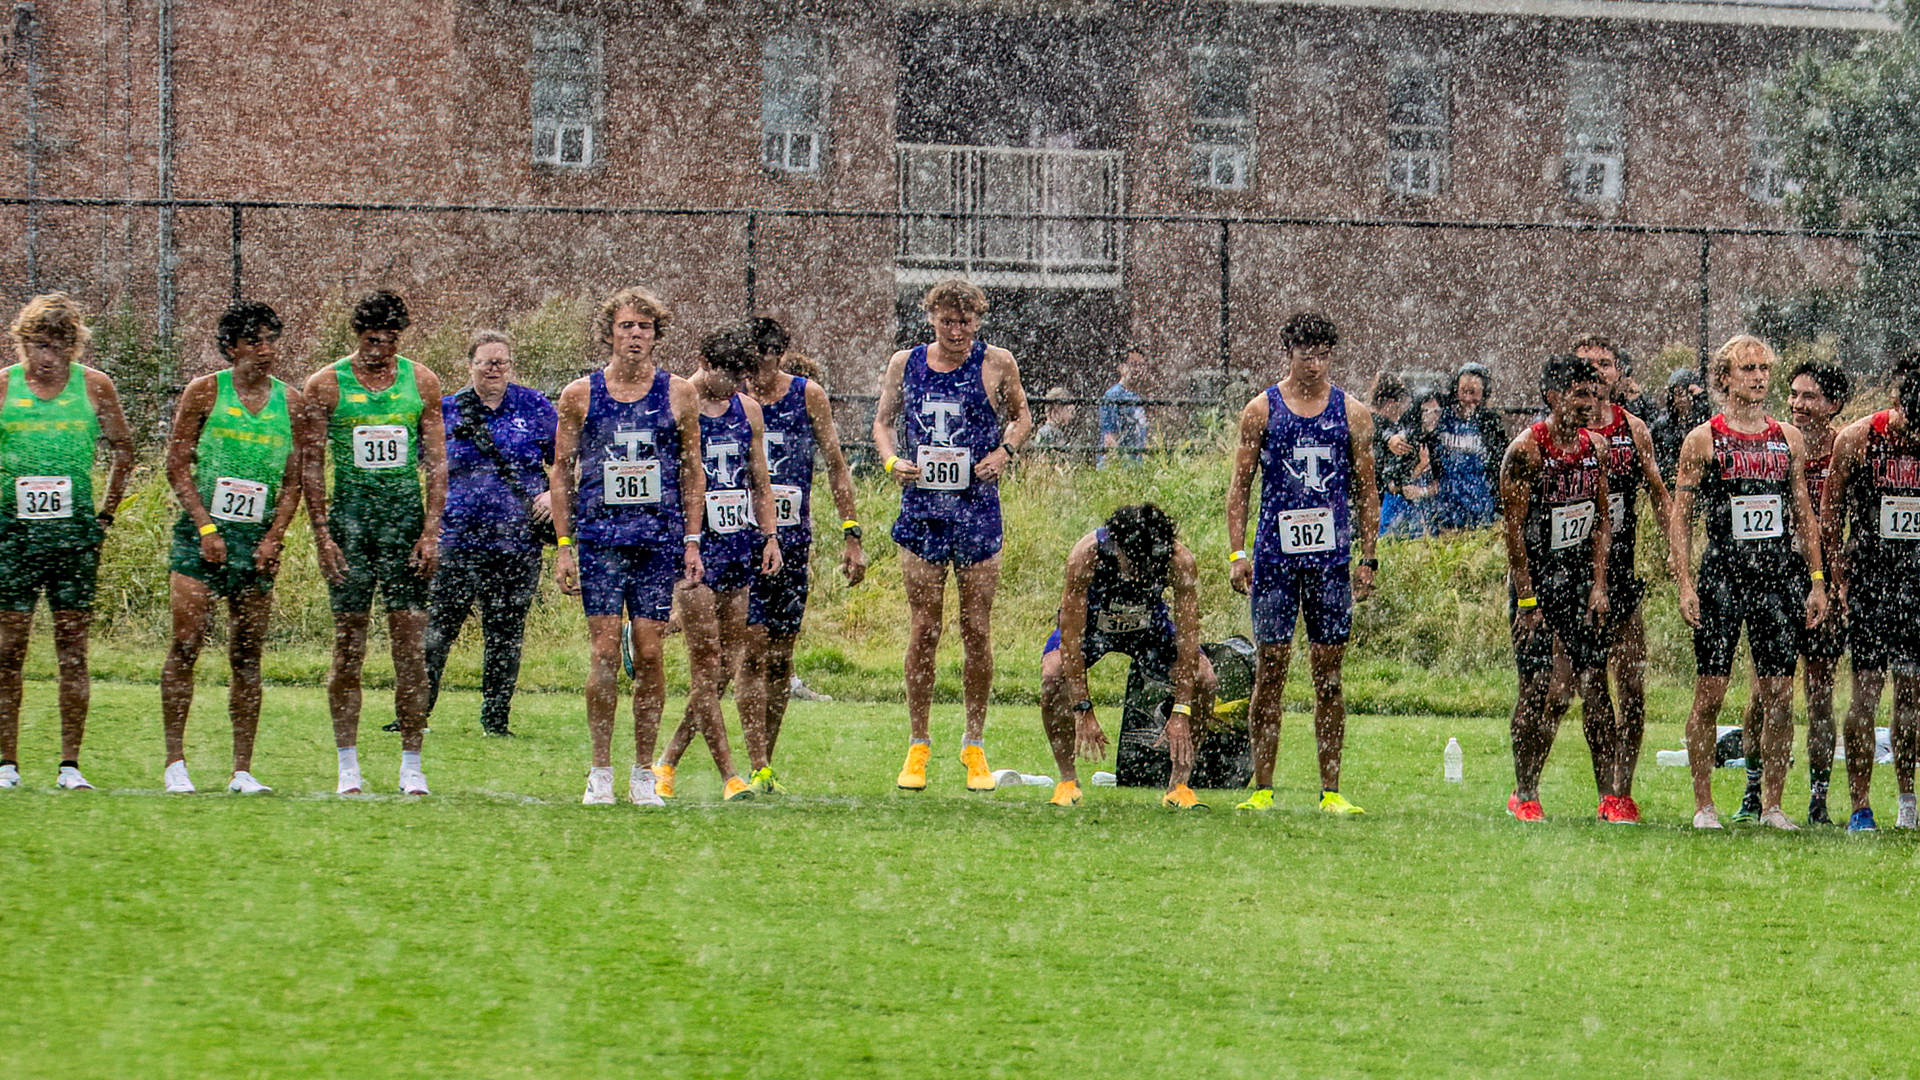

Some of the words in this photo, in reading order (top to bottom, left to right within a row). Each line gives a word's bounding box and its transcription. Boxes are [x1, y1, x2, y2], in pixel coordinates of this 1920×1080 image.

[364, 440, 398, 462] 319
[925, 461, 960, 484] 360
[1717, 450, 1789, 481] LAMAR
[615, 476, 650, 498] 361
[26, 491, 61, 514] 326
[222, 492, 255, 517] 321
[717, 505, 745, 527] 358
[1743, 510, 1773, 533] 122
[1290, 523, 1326, 547] 362
[1561, 516, 1588, 542] 127
